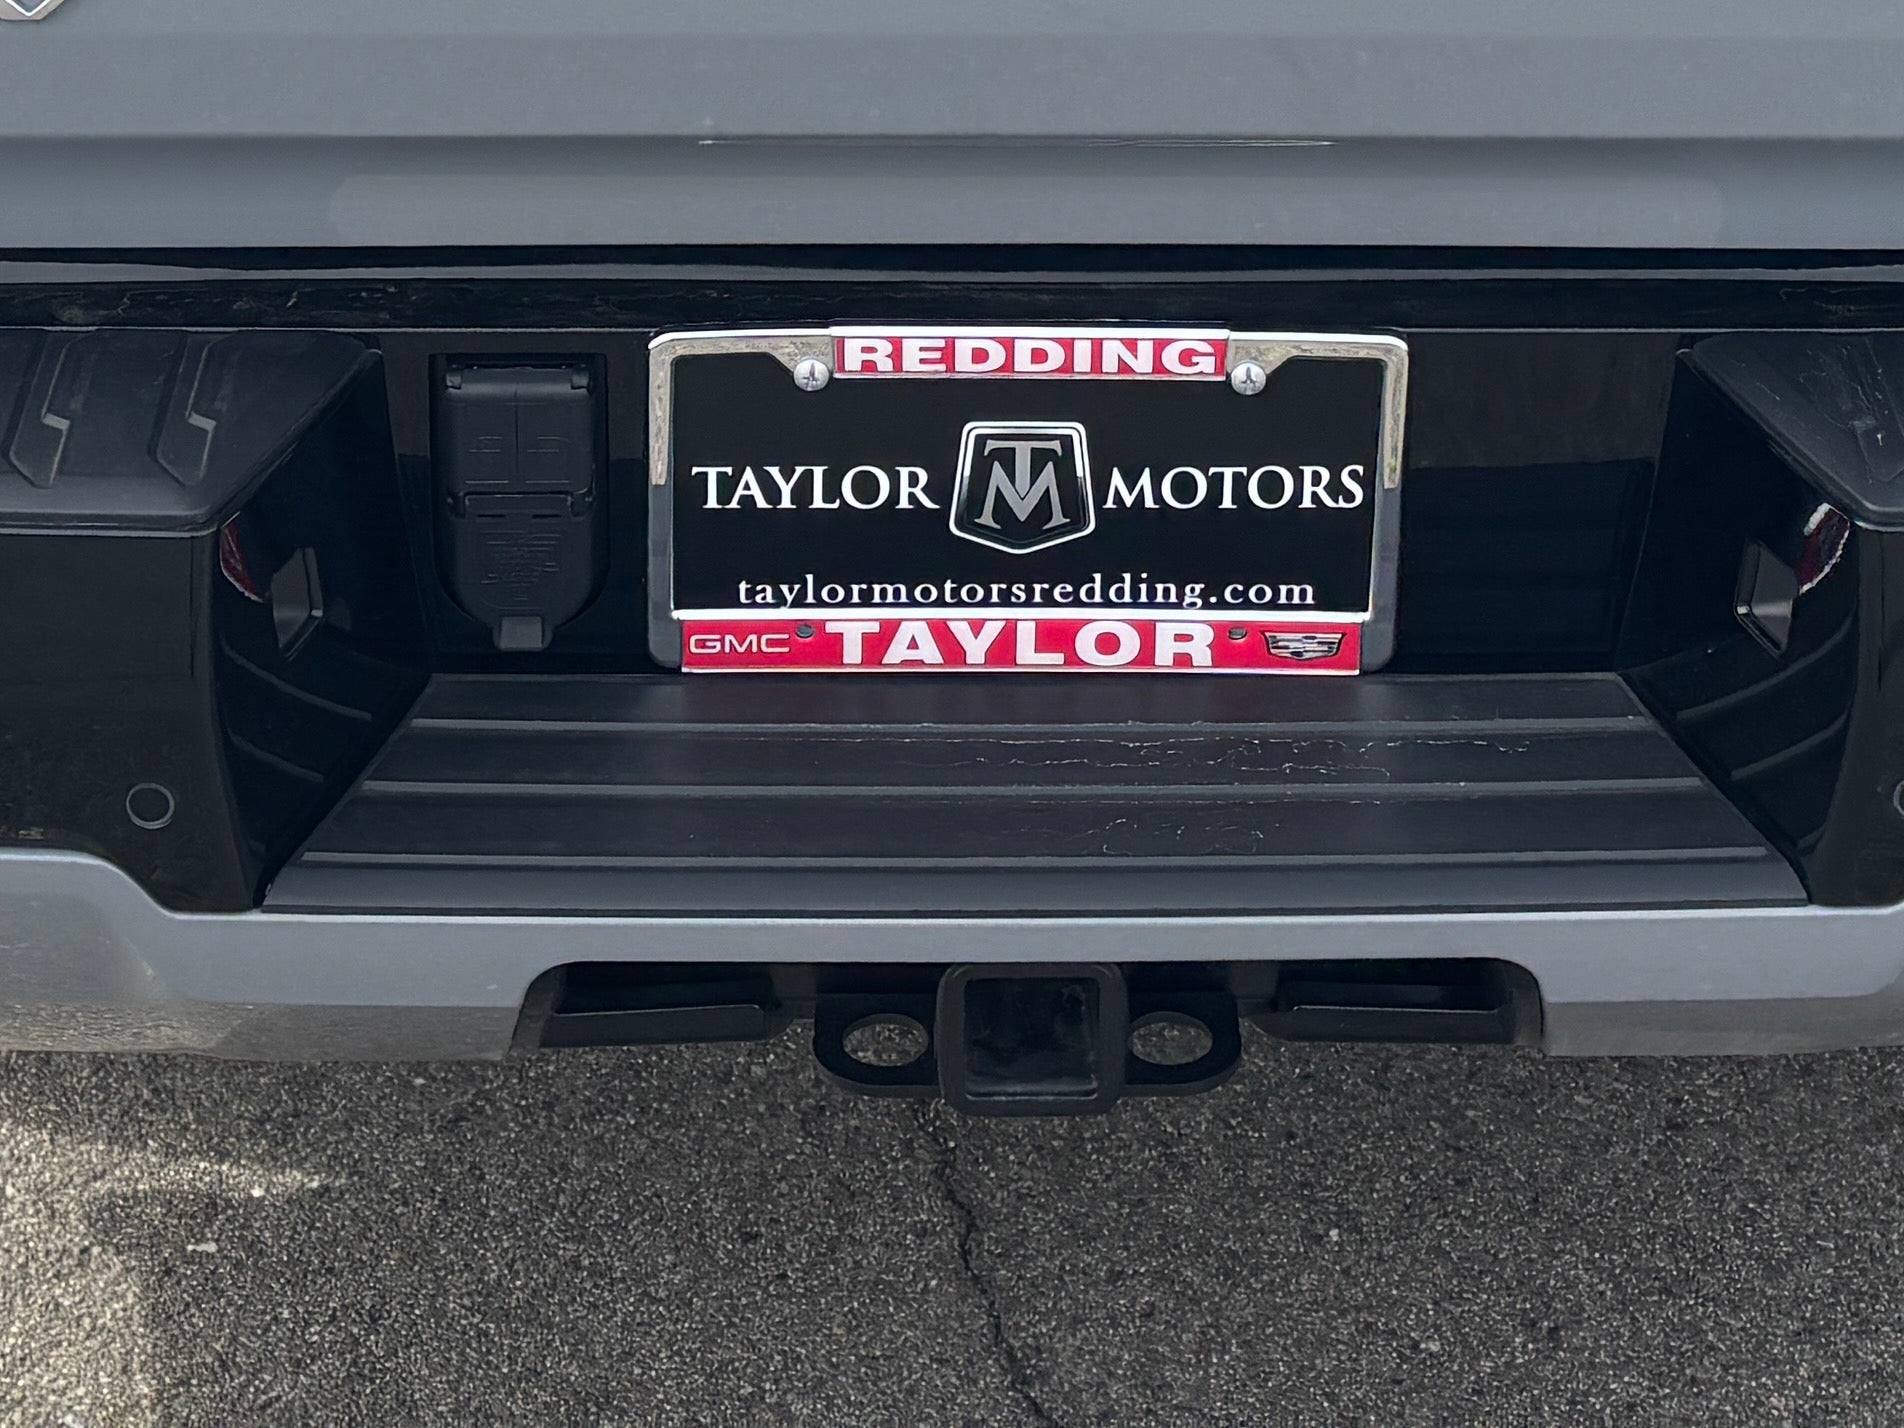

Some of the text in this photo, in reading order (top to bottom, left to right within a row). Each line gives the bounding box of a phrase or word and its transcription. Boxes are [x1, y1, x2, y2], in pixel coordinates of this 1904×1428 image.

[842, 337, 1217, 375] REDDING
[691, 465, 940, 510] TAYLOR
[1102, 464, 1366, 510] MOTORS
[737, 573, 1315, 610] taylormotorsredding.com
[689, 620, 1216, 668] GMC TAYLOR
